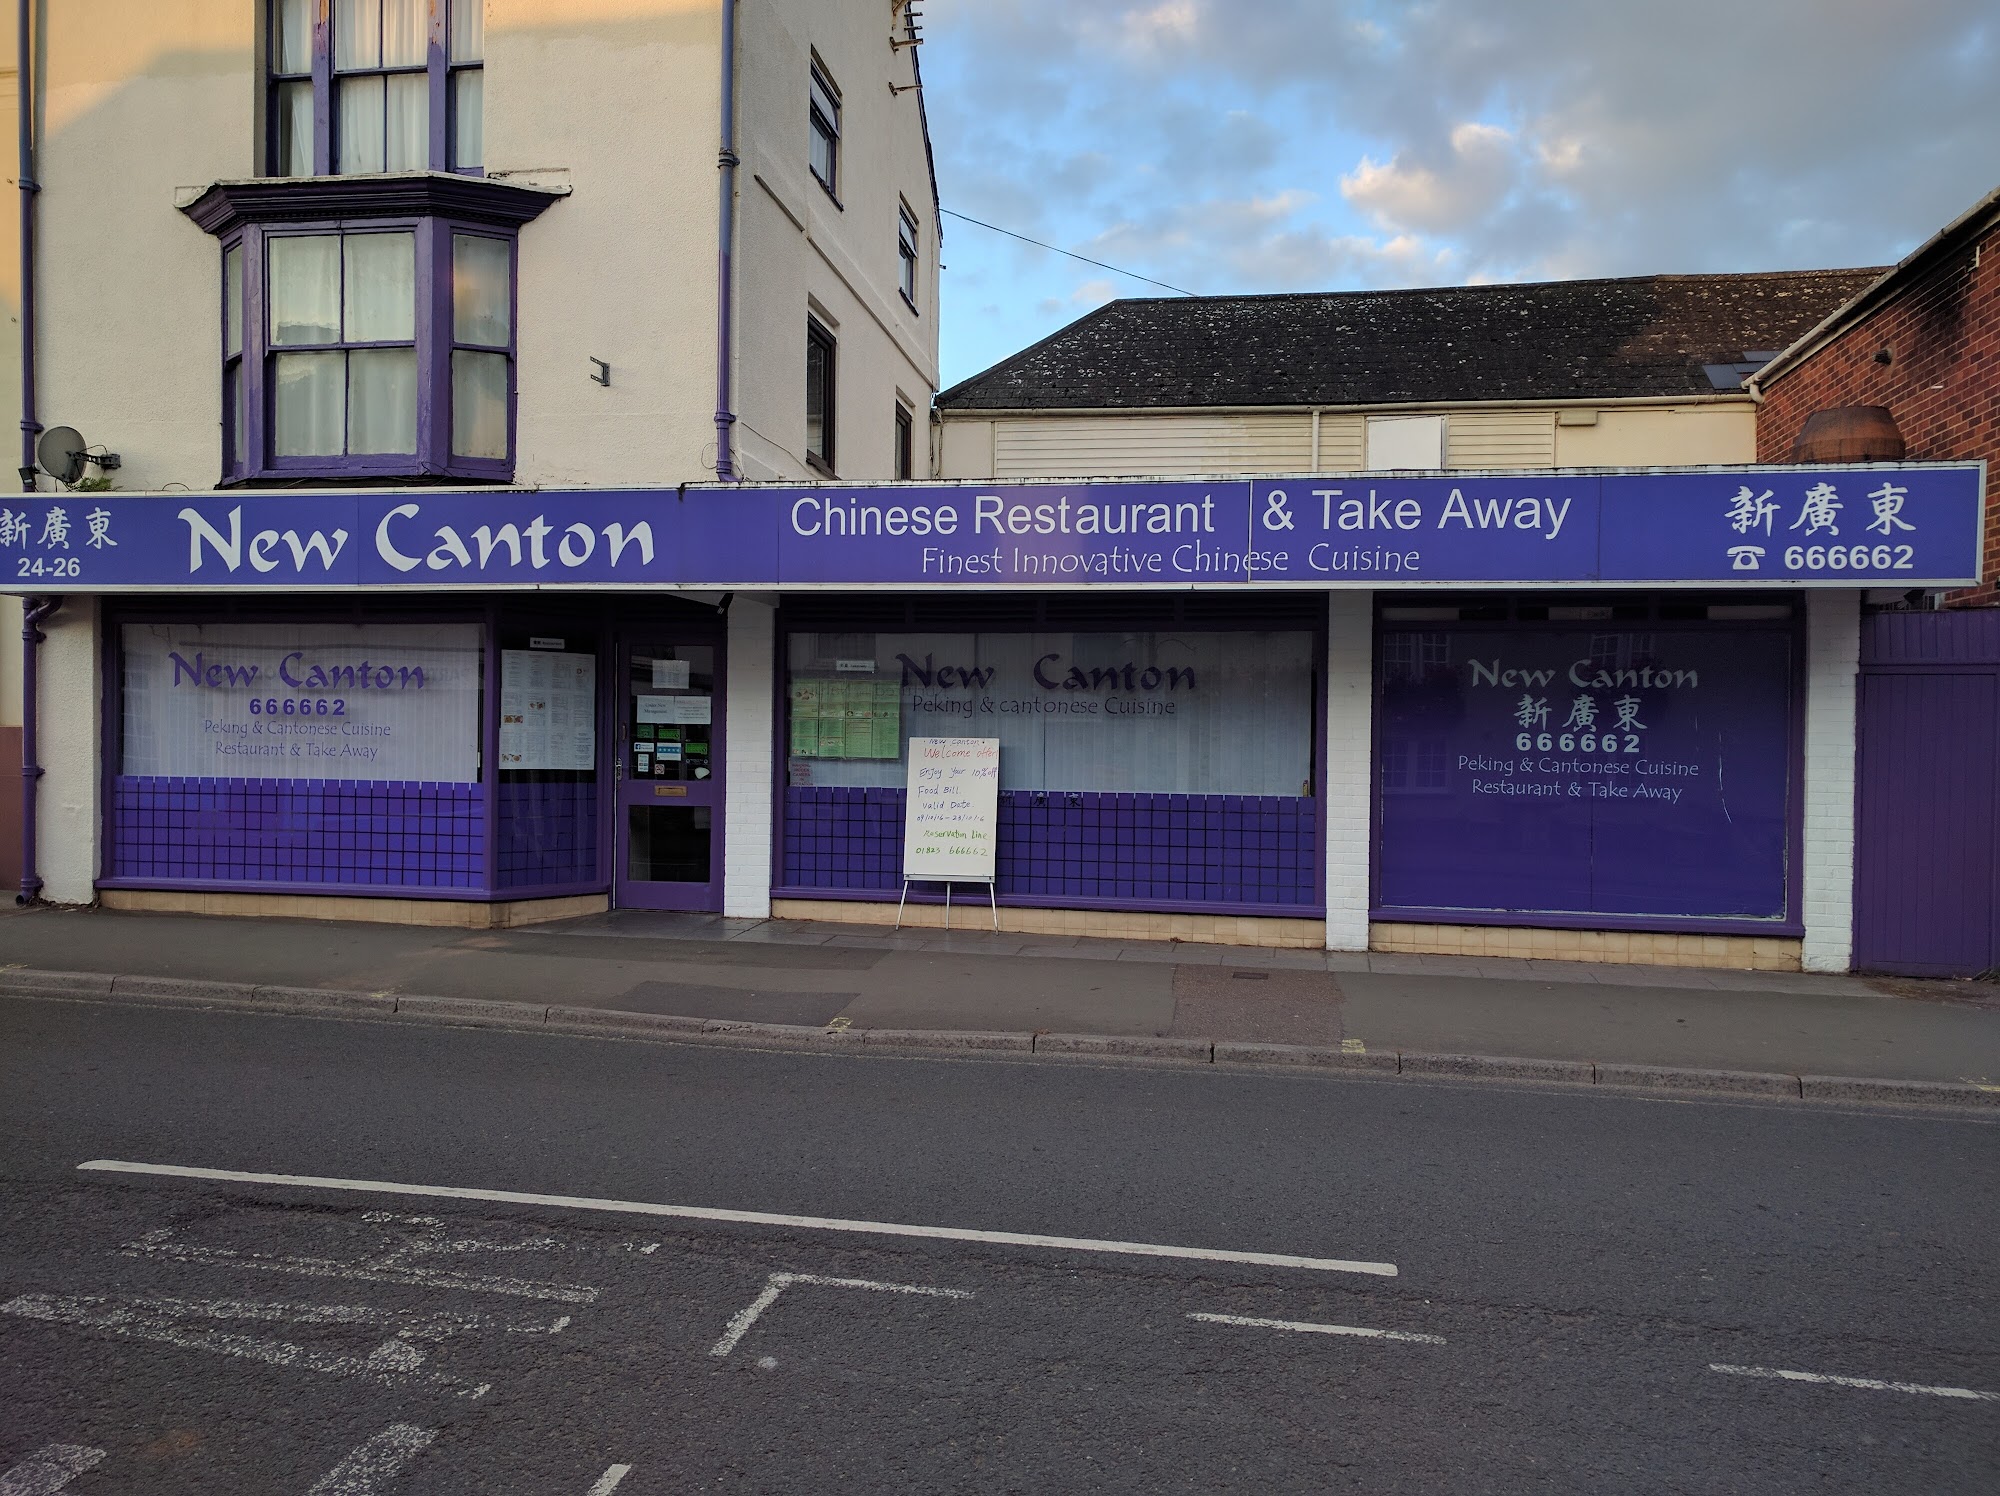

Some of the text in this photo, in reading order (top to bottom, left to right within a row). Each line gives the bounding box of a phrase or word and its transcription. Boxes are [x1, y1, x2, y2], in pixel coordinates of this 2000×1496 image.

[792, 488, 1572, 540] Chinese Restaurant & Take Away
[1724, 482, 1917, 536] 新廣東
[0, 506, 118, 550] 新廣東
[177, 503, 655, 574] New Canton
[17, 557, 81, 577] 24-26
[922, 539, 1420, 576] Finest Innovative Chinese Cuisine
[1784, 544, 1914, 570] 666662
[168, 651, 259, 688] New
[279, 652, 425, 689] Canton
[896, 652, 1196, 691] New Canton
[1467, 658, 1698, 689] New Canton
[249, 698, 345, 716] 666662
[912, 694, 1175, 719] Peking & cantonese Cuisine
[1513, 693, 1648, 733] 新廣東
[204, 718, 391, 739] Peking & Cantonese Cuisine
[215, 741, 379, 763] Restaurant & Take Away
[924, 745, 971, 759] Welcome
[1515, 732, 1640, 753] 666662
[919, 767, 943, 780] Enjoy
[1458, 755, 1700, 777] Peking & Cantonese Cuisine
[918, 784, 940, 797] Food
[1472, 778, 1683, 805] Restaurant & Take Away
[915, 845, 989, 857] 01823 666662
